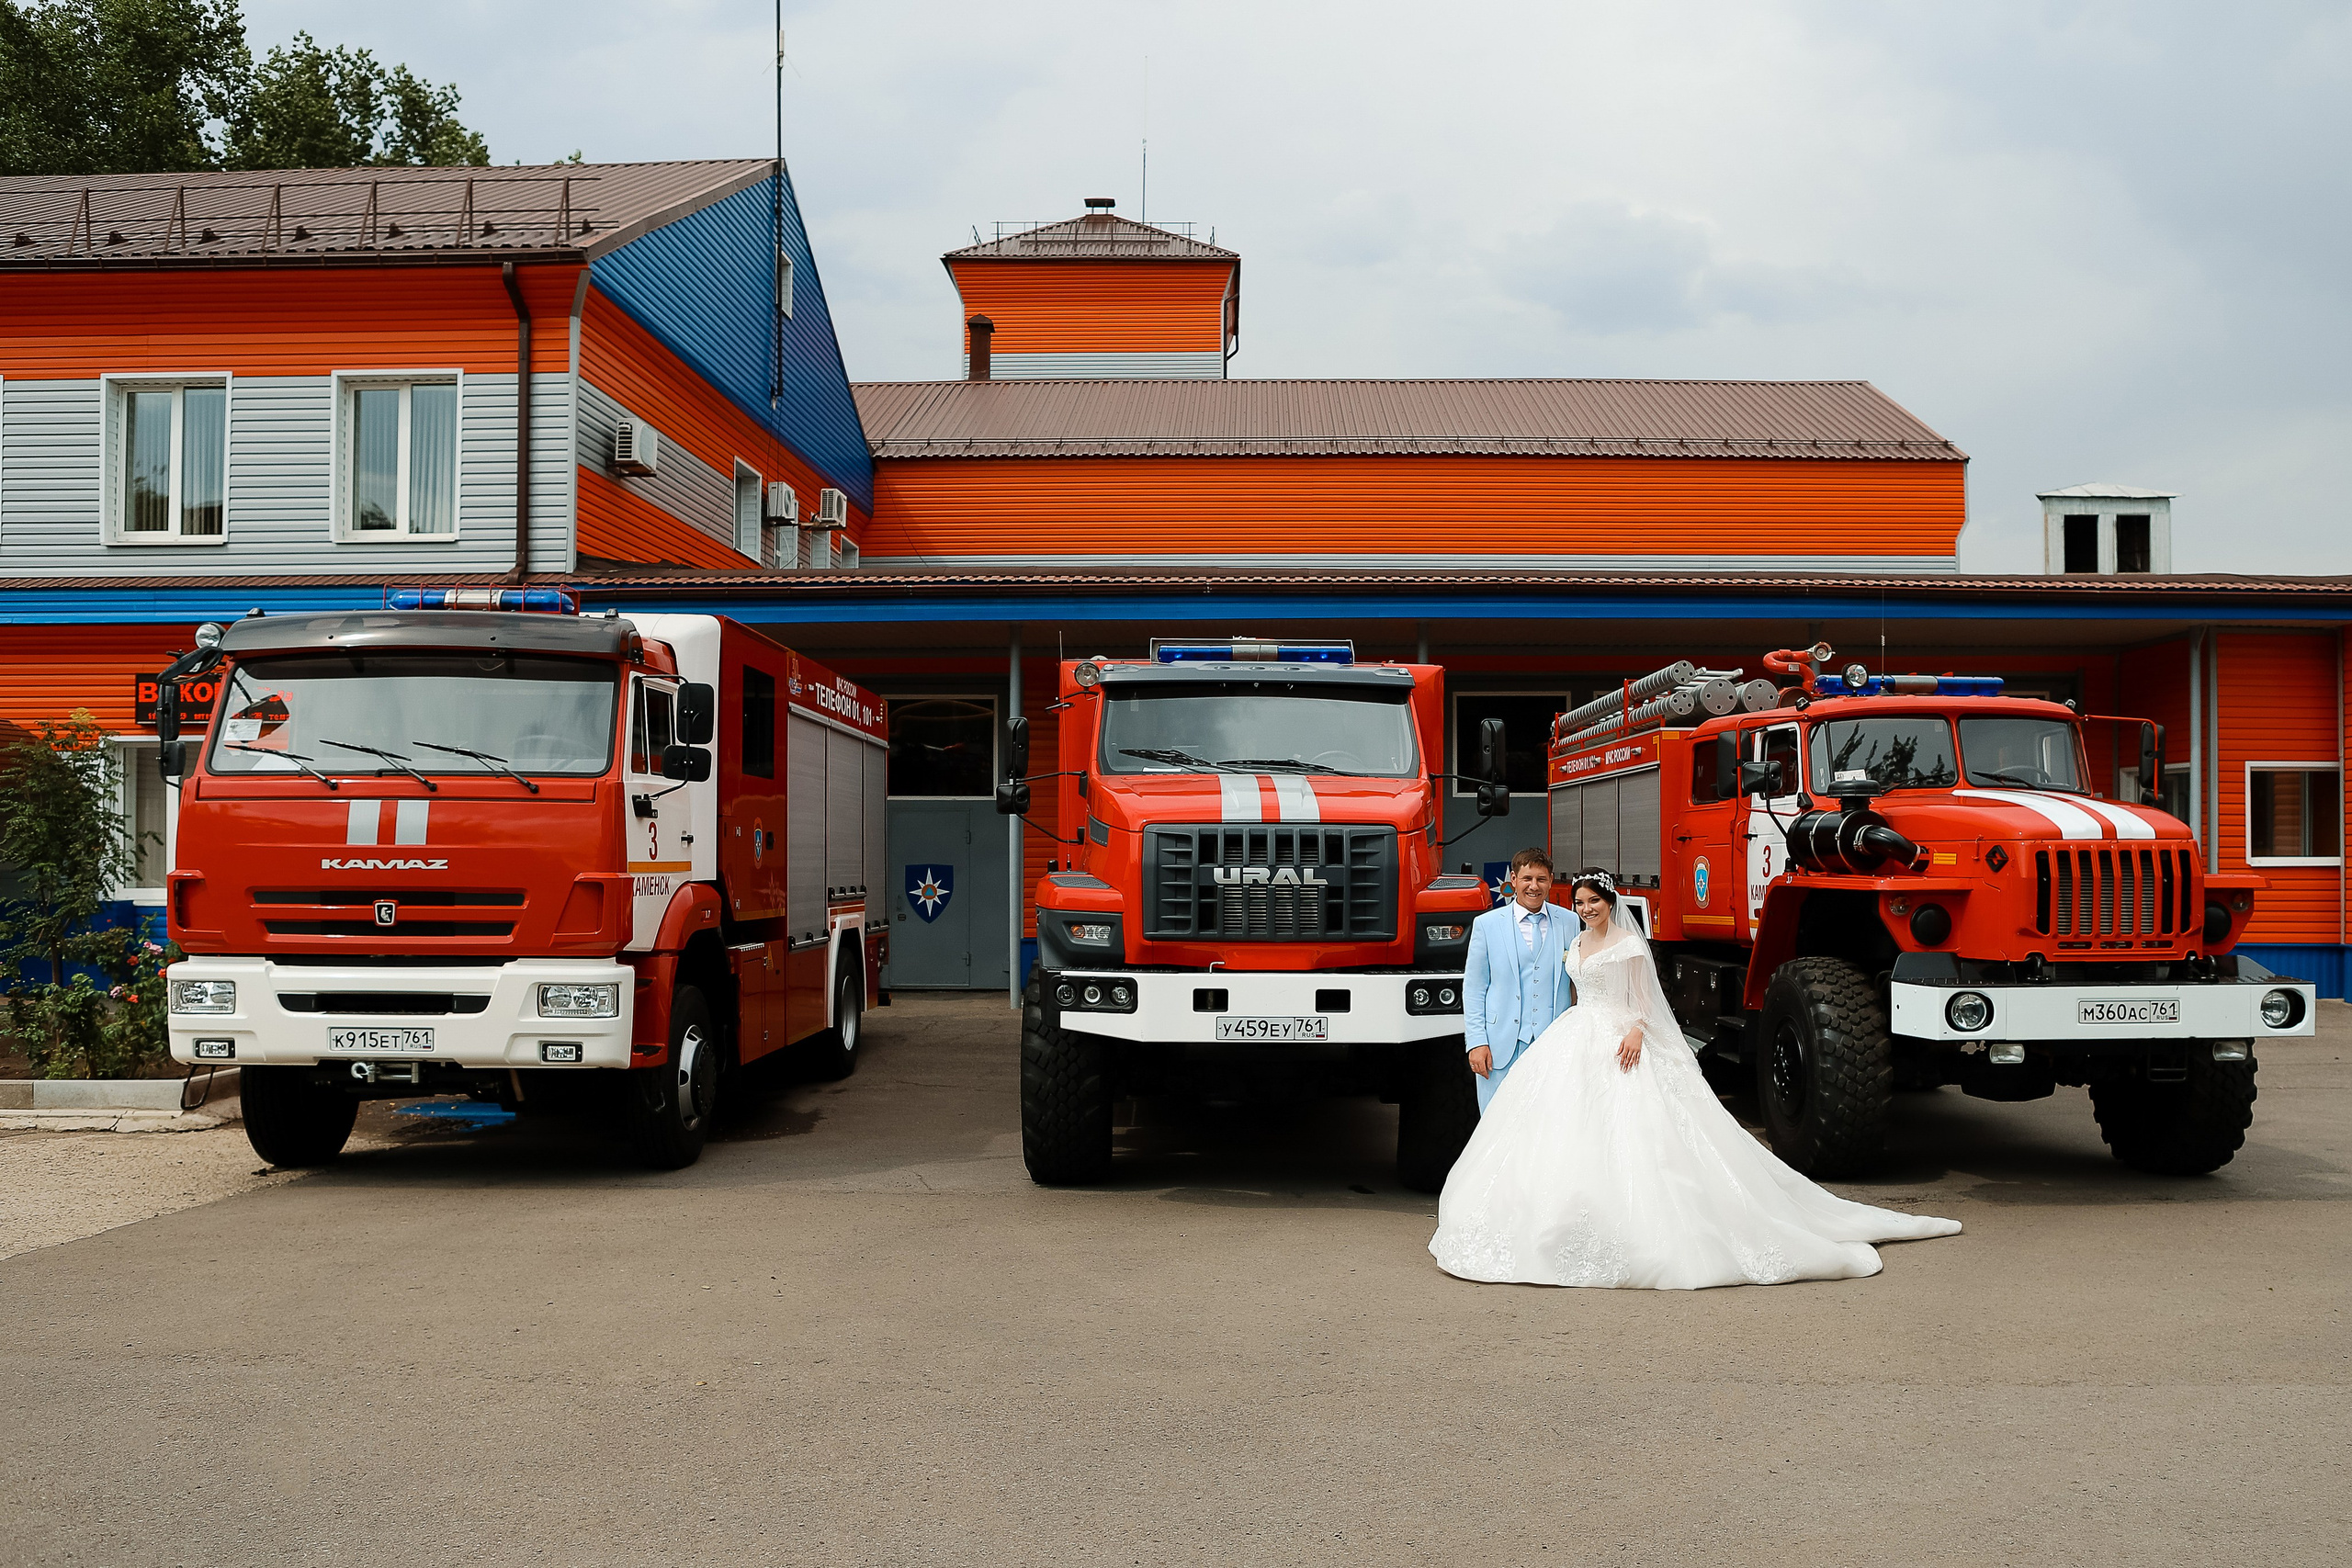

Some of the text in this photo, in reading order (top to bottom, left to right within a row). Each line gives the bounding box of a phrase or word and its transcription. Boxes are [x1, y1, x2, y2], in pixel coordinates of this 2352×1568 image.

[815, 682, 852, 718] ТЕЛЕФОН
[863, 705, 872, 727] 101
[649, 821, 658, 861] 3
[321, 859, 448, 869] KAMAZ
[1762, 845, 1771, 878] 3
[632, 875, 671, 897] АМЕНСК
[1213, 867, 1329, 886] URAL
[2151, 1002, 2177, 1016] 761
[1295, 1019, 1322, 1032] 761
[403, 1032, 429, 1044] 761
